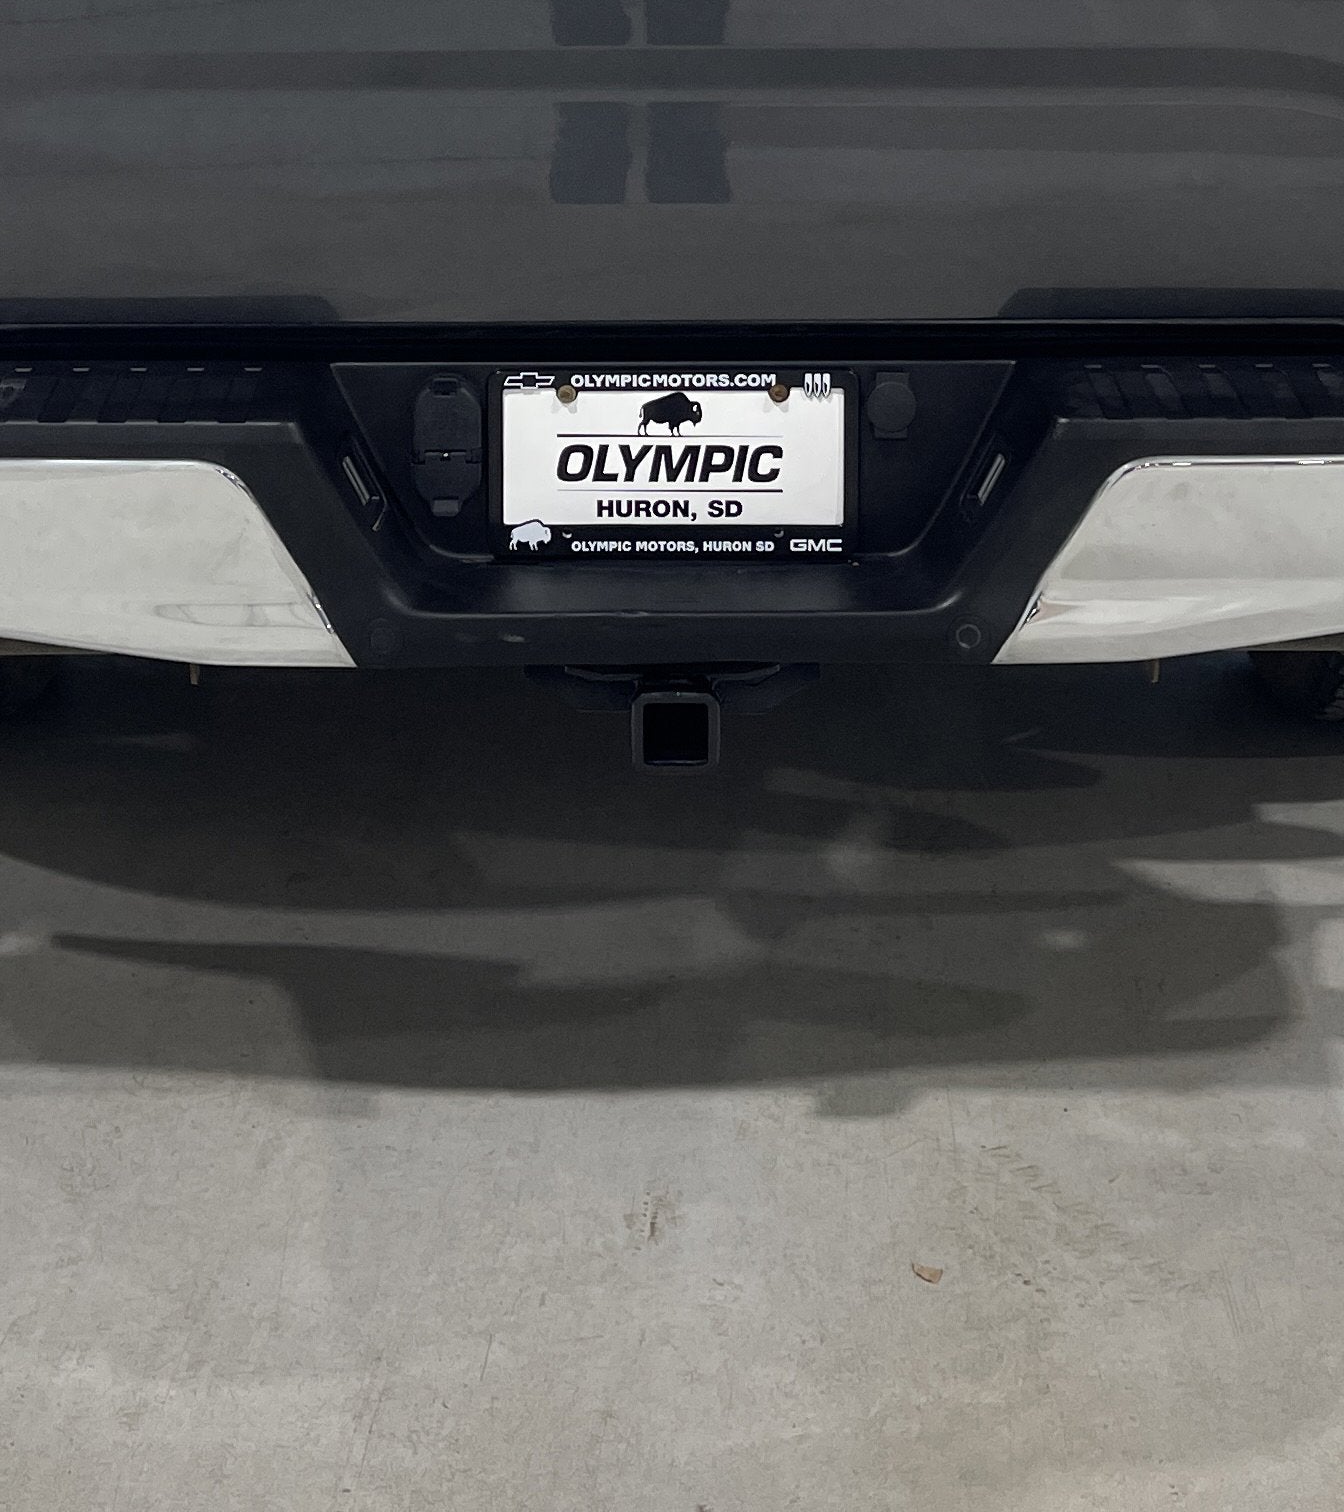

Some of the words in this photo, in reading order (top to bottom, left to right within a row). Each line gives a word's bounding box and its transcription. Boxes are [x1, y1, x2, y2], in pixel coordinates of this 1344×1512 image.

[570, 373, 777, 388] OLYMPICMOTORS.COM
[556, 444, 784, 483] OLYMPIC
[596, 500, 697, 521] HURON,
[707, 500, 743, 518] SD
[571, 541, 632, 552] OLYMPIC
[635, 541, 699, 553] MOTORS,
[703, 541, 753, 552] HURON
[756, 541, 775, 552] SD
[790, 539, 843, 552] GMC
